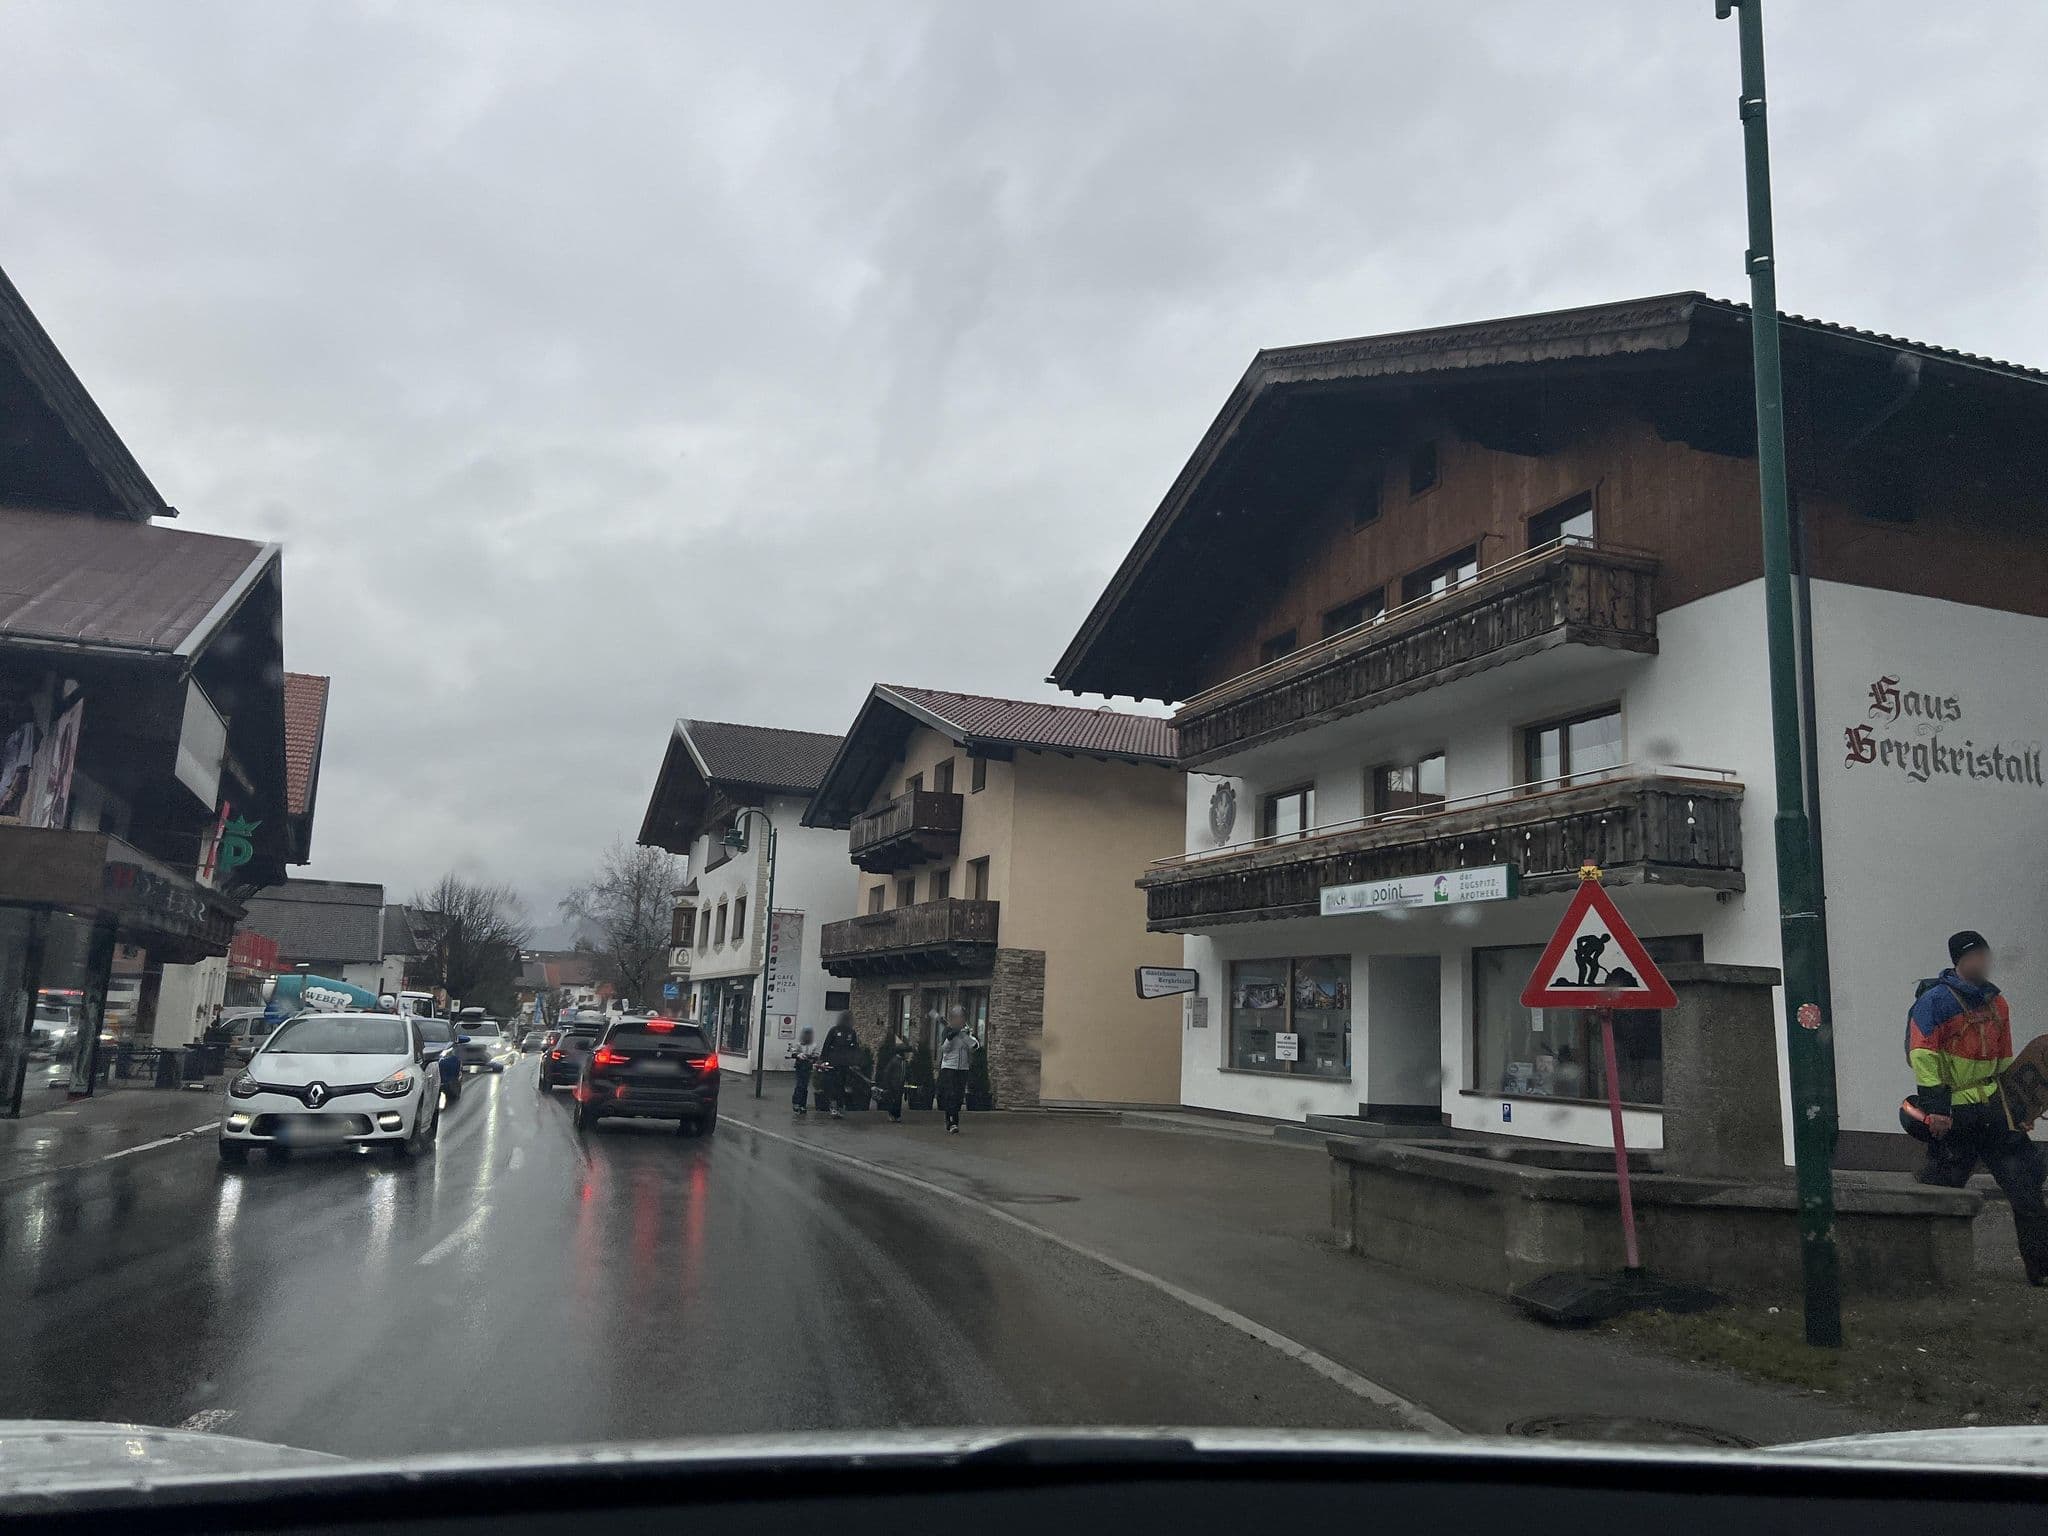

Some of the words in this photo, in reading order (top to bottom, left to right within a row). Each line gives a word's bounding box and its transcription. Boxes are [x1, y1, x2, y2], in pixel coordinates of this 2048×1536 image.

[1868, 675, 1961, 726] Haus
[1844, 724, 2044, 787] Bergkristall
[1460, 878, 1500, 890] ZUGSPITZ-
[1372, 883, 1403, 904] point
[1460, 889, 1501, 901] APOTHEKE
[306, 991, 346, 1006] WEBER
